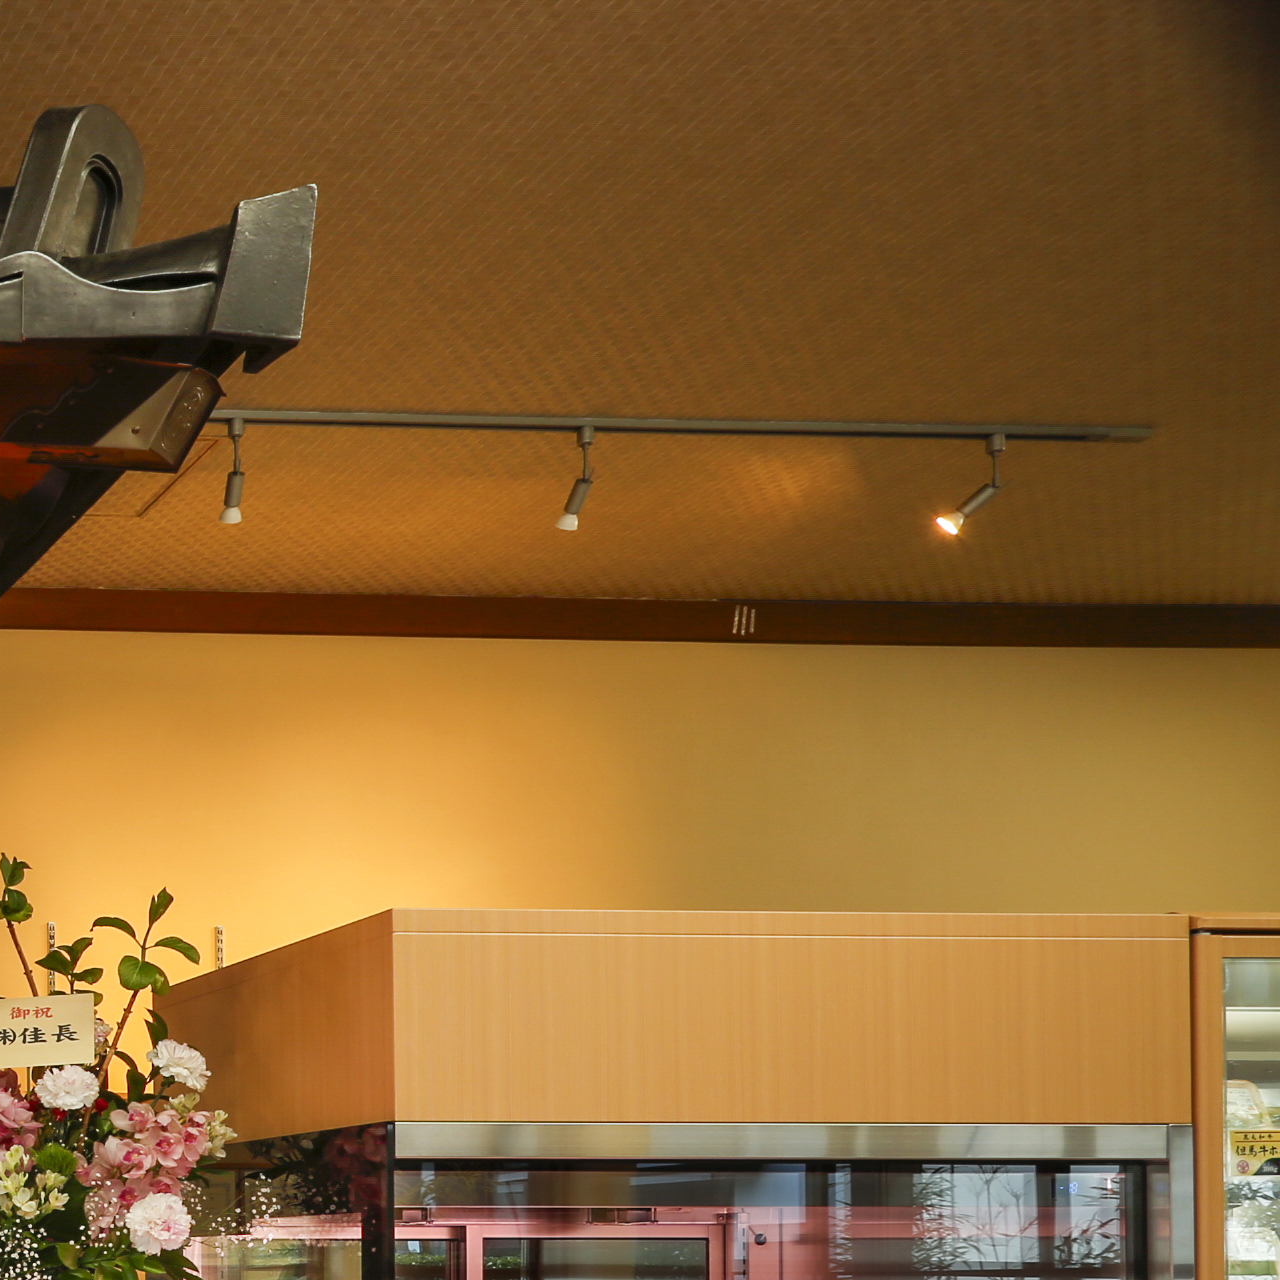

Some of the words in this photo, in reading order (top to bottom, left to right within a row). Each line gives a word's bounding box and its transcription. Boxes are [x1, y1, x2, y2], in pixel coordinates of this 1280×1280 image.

[10, 1006, 53, 1020] 御祝
[1235, 1145, 1280, 1157] 但馬牛ホ
